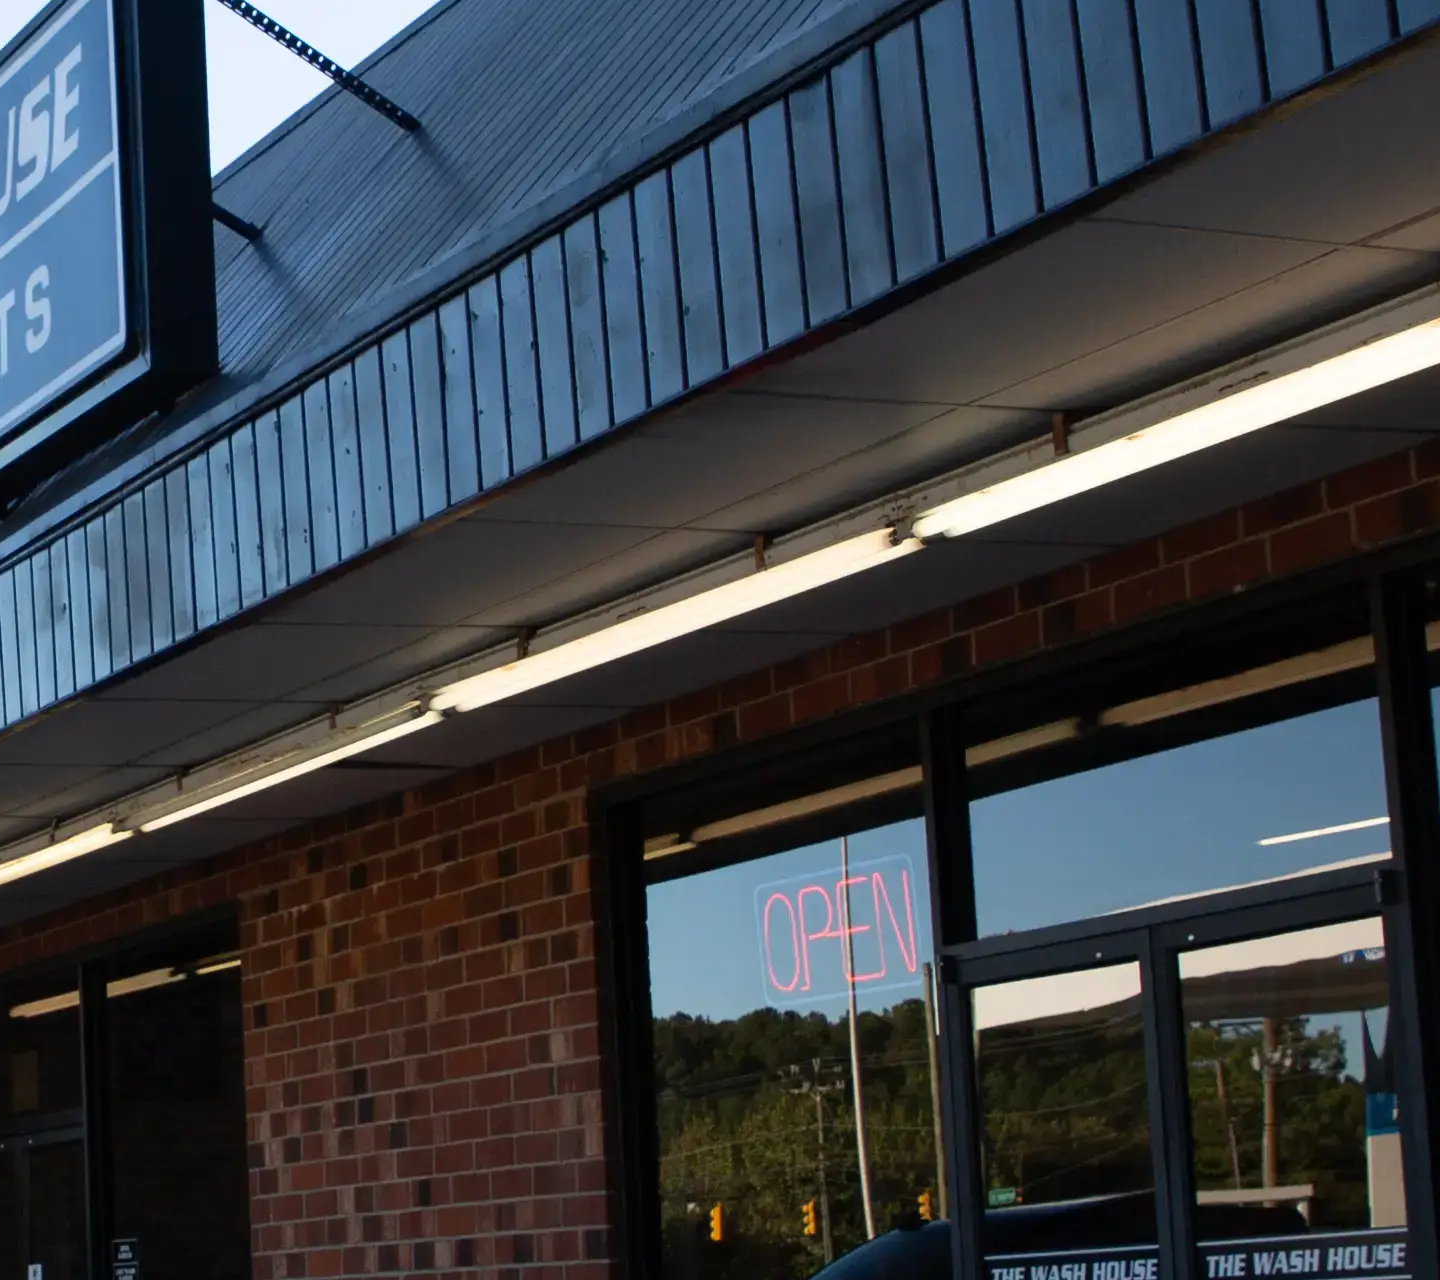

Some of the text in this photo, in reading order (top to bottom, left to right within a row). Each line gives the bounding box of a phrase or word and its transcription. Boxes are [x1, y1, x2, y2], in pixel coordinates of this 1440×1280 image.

[763, 869, 917, 991] OPEN
[1206, 1243, 1407, 1279] THE WASH HOUSE
